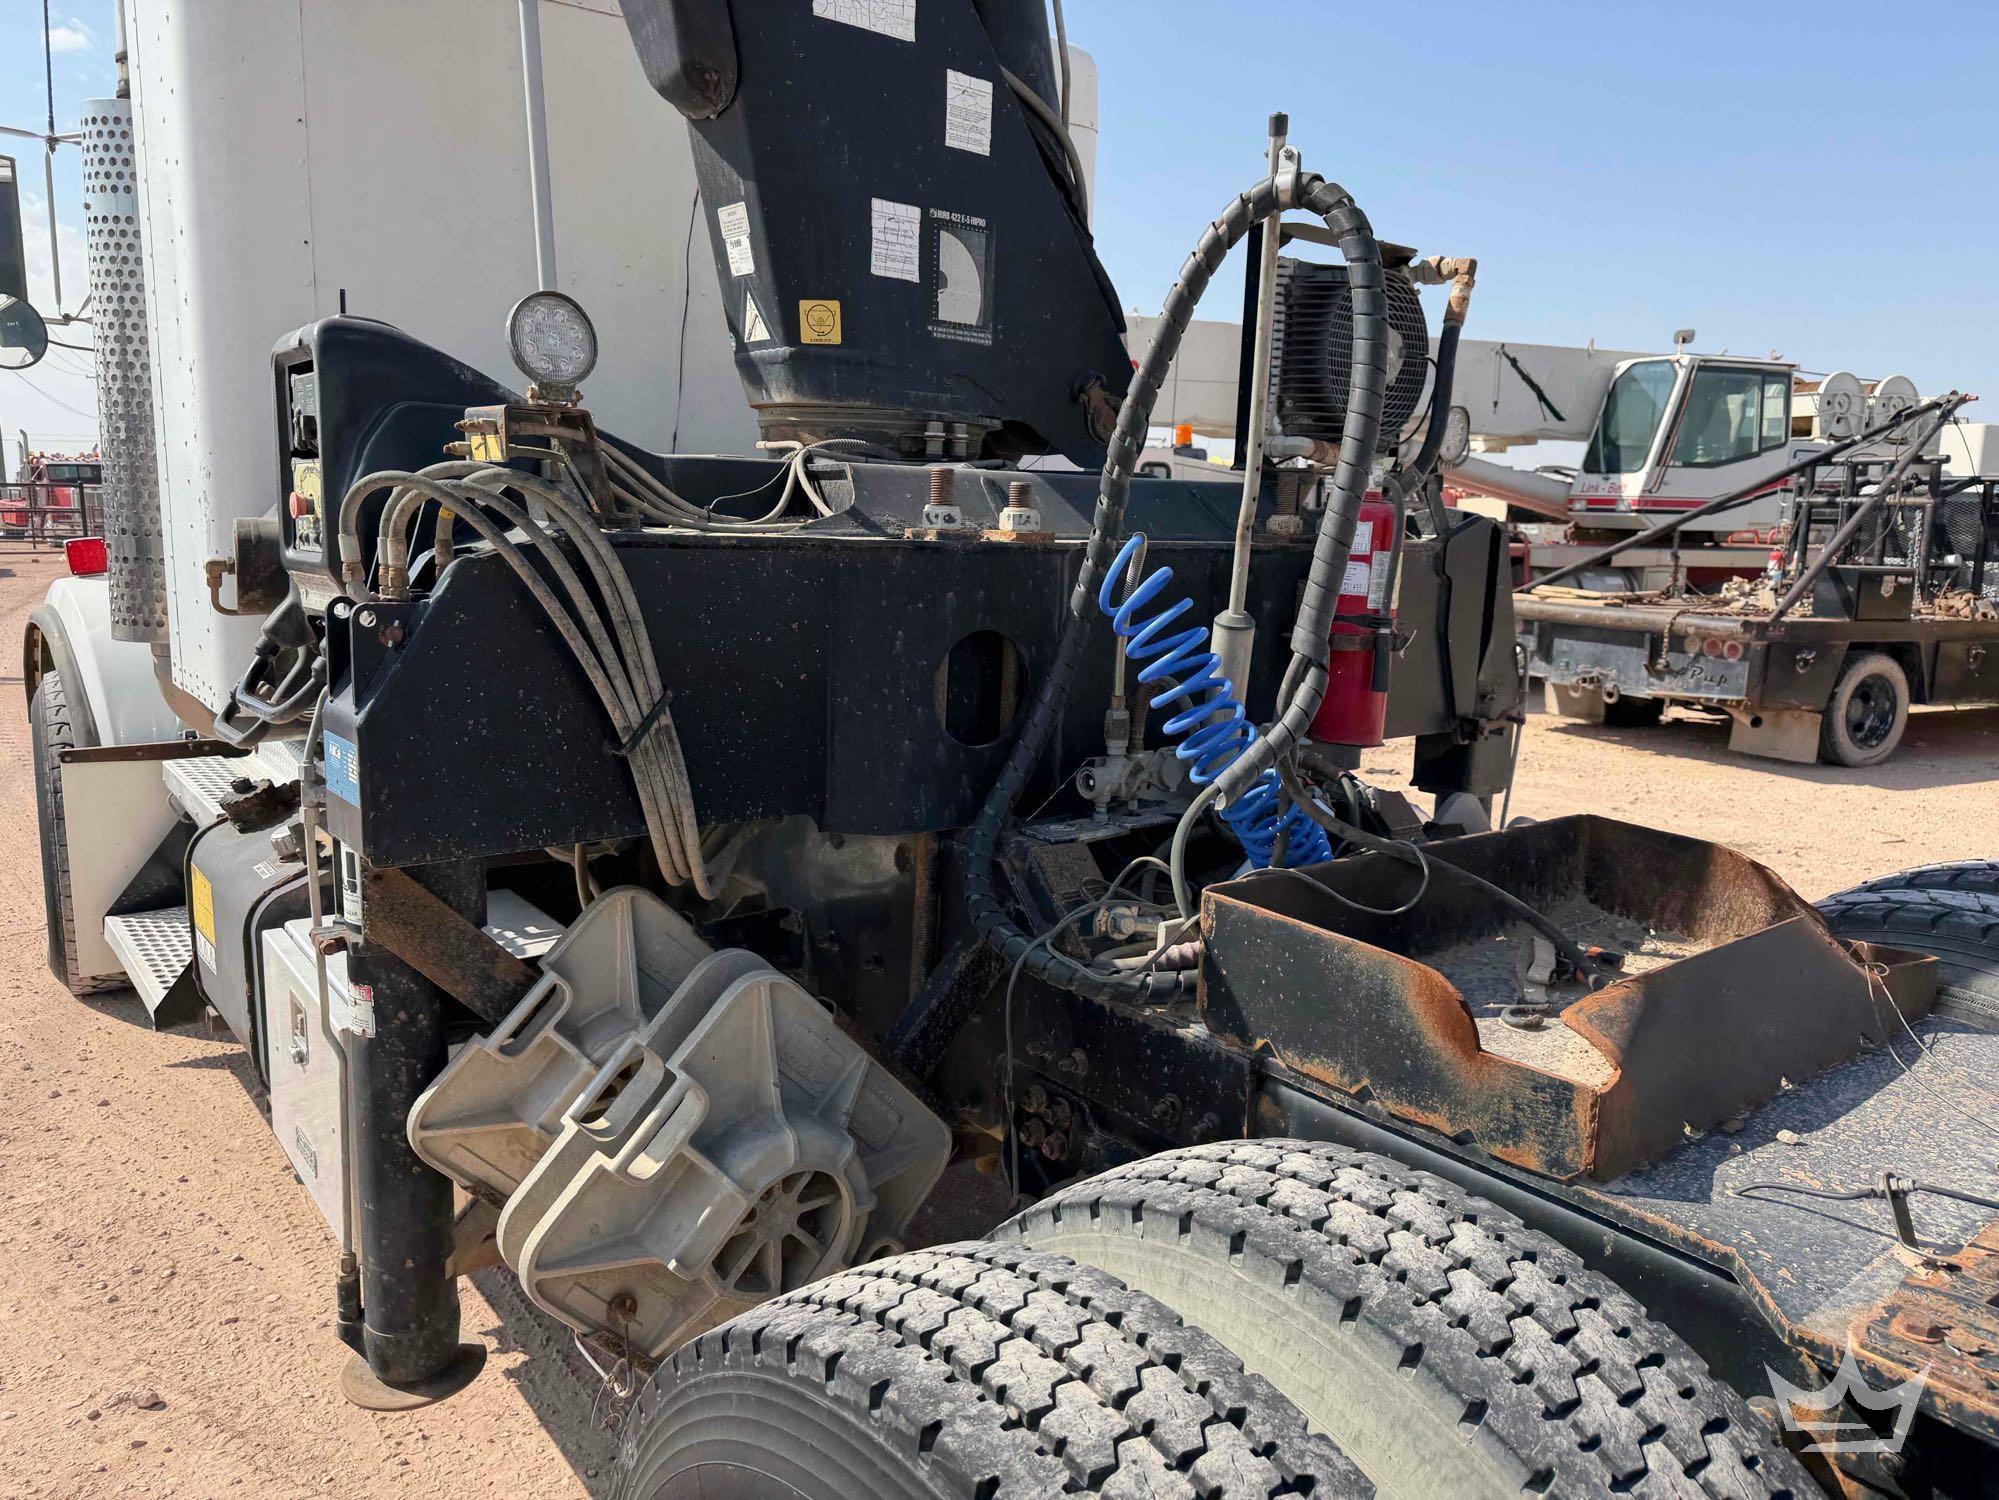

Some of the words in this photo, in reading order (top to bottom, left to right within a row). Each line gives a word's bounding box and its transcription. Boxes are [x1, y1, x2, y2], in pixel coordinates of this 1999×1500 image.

[937, 209, 950, 220] HIAB
[950, 212, 961, 222] 422
[961, 214, 971, 224] E-5
[970, 216, 987, 228] HIPRO
